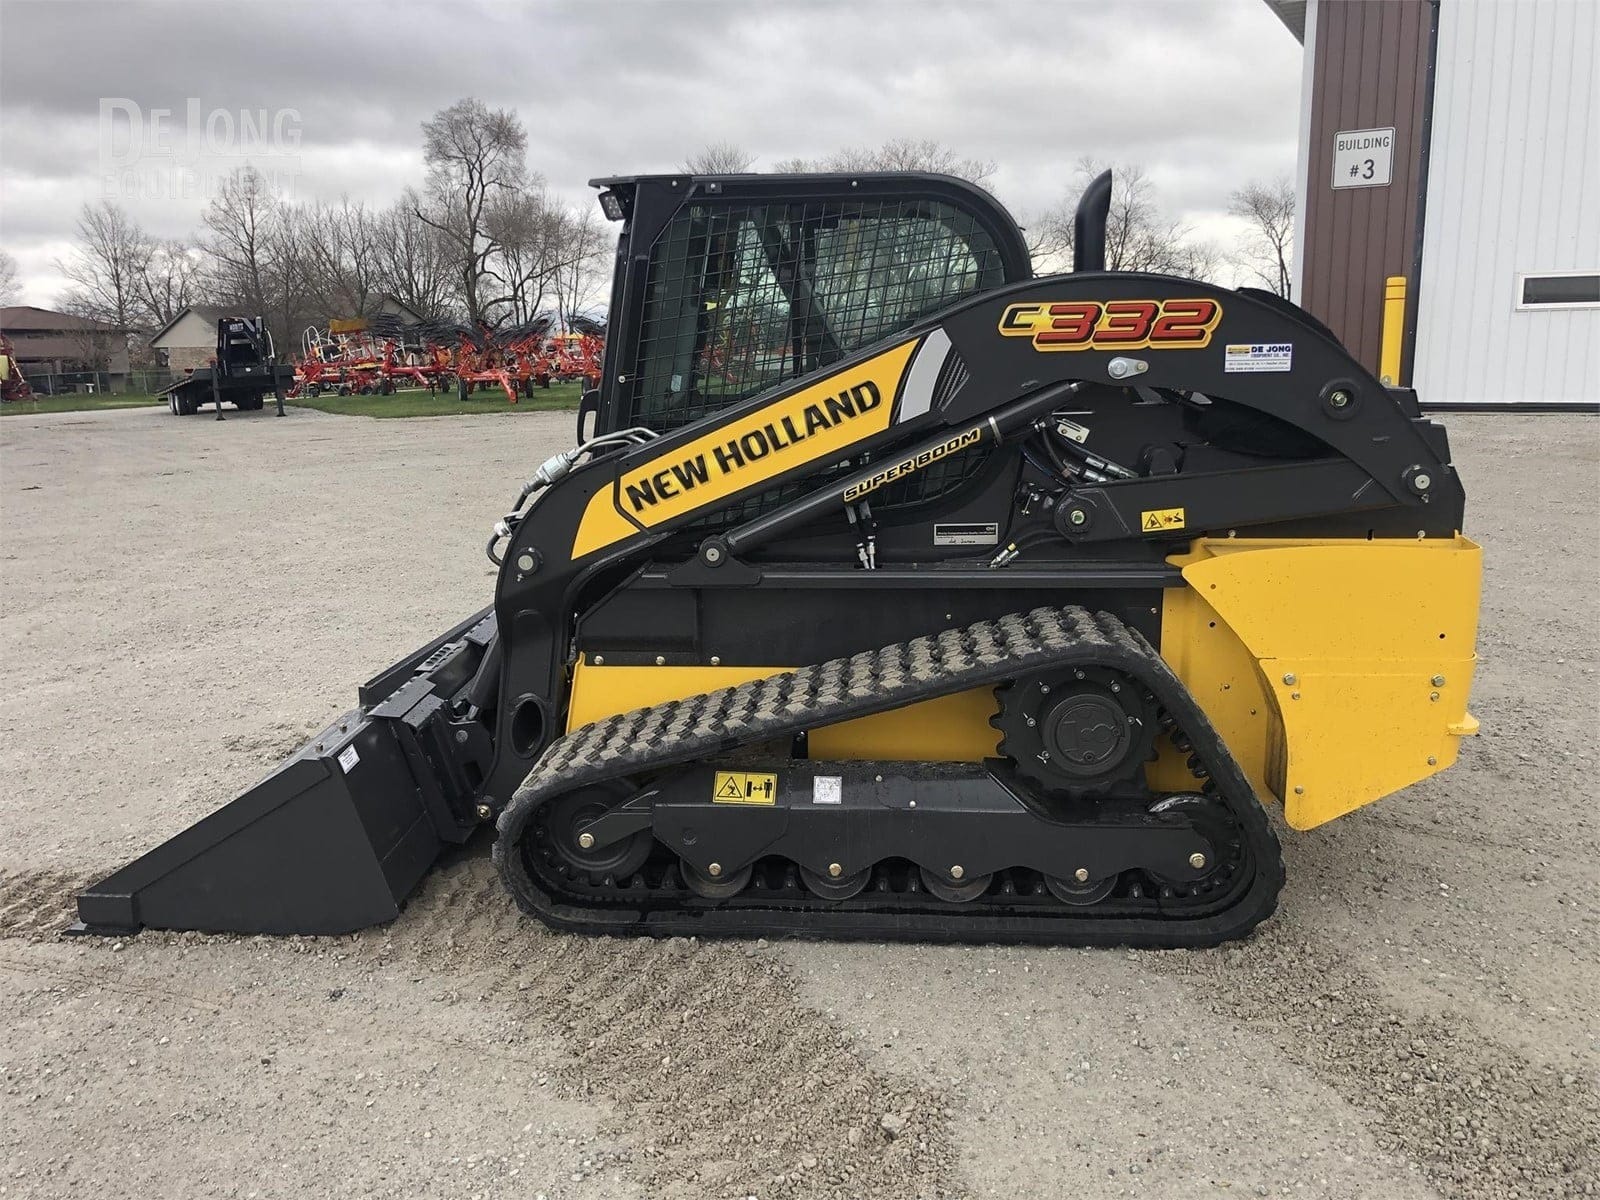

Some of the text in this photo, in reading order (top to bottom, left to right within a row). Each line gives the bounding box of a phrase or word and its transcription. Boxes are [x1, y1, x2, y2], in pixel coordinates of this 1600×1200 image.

[1338, 136, 1390, 151] BUILDING
[1000, 299, 1221, 349] C332
[1266, 345, 1291, 353] JONG
[625, 380, 881, 512] NEW HOLLAND
[844, 428, 980, 501] SUPER BOOM
